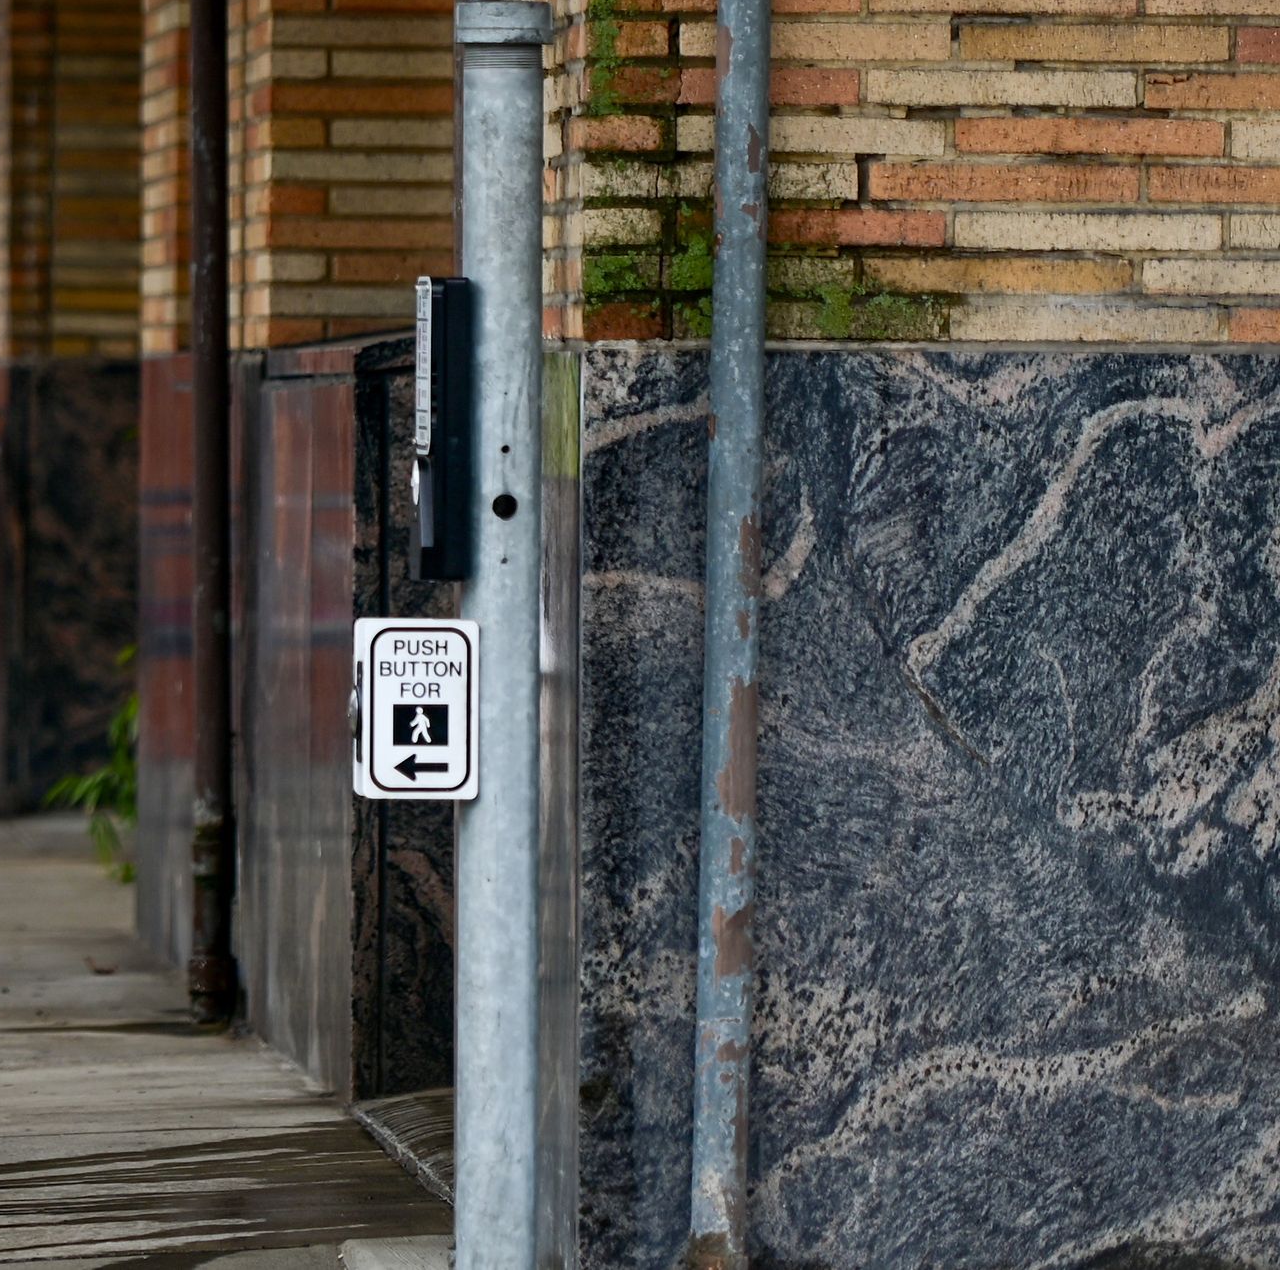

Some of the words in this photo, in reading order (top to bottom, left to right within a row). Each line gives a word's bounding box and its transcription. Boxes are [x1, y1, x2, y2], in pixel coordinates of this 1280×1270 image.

[394, 640, 448, 655] PUSH
[379, 660, 463, 678] BUTTON
[400, 682, 441, 699] FOR
